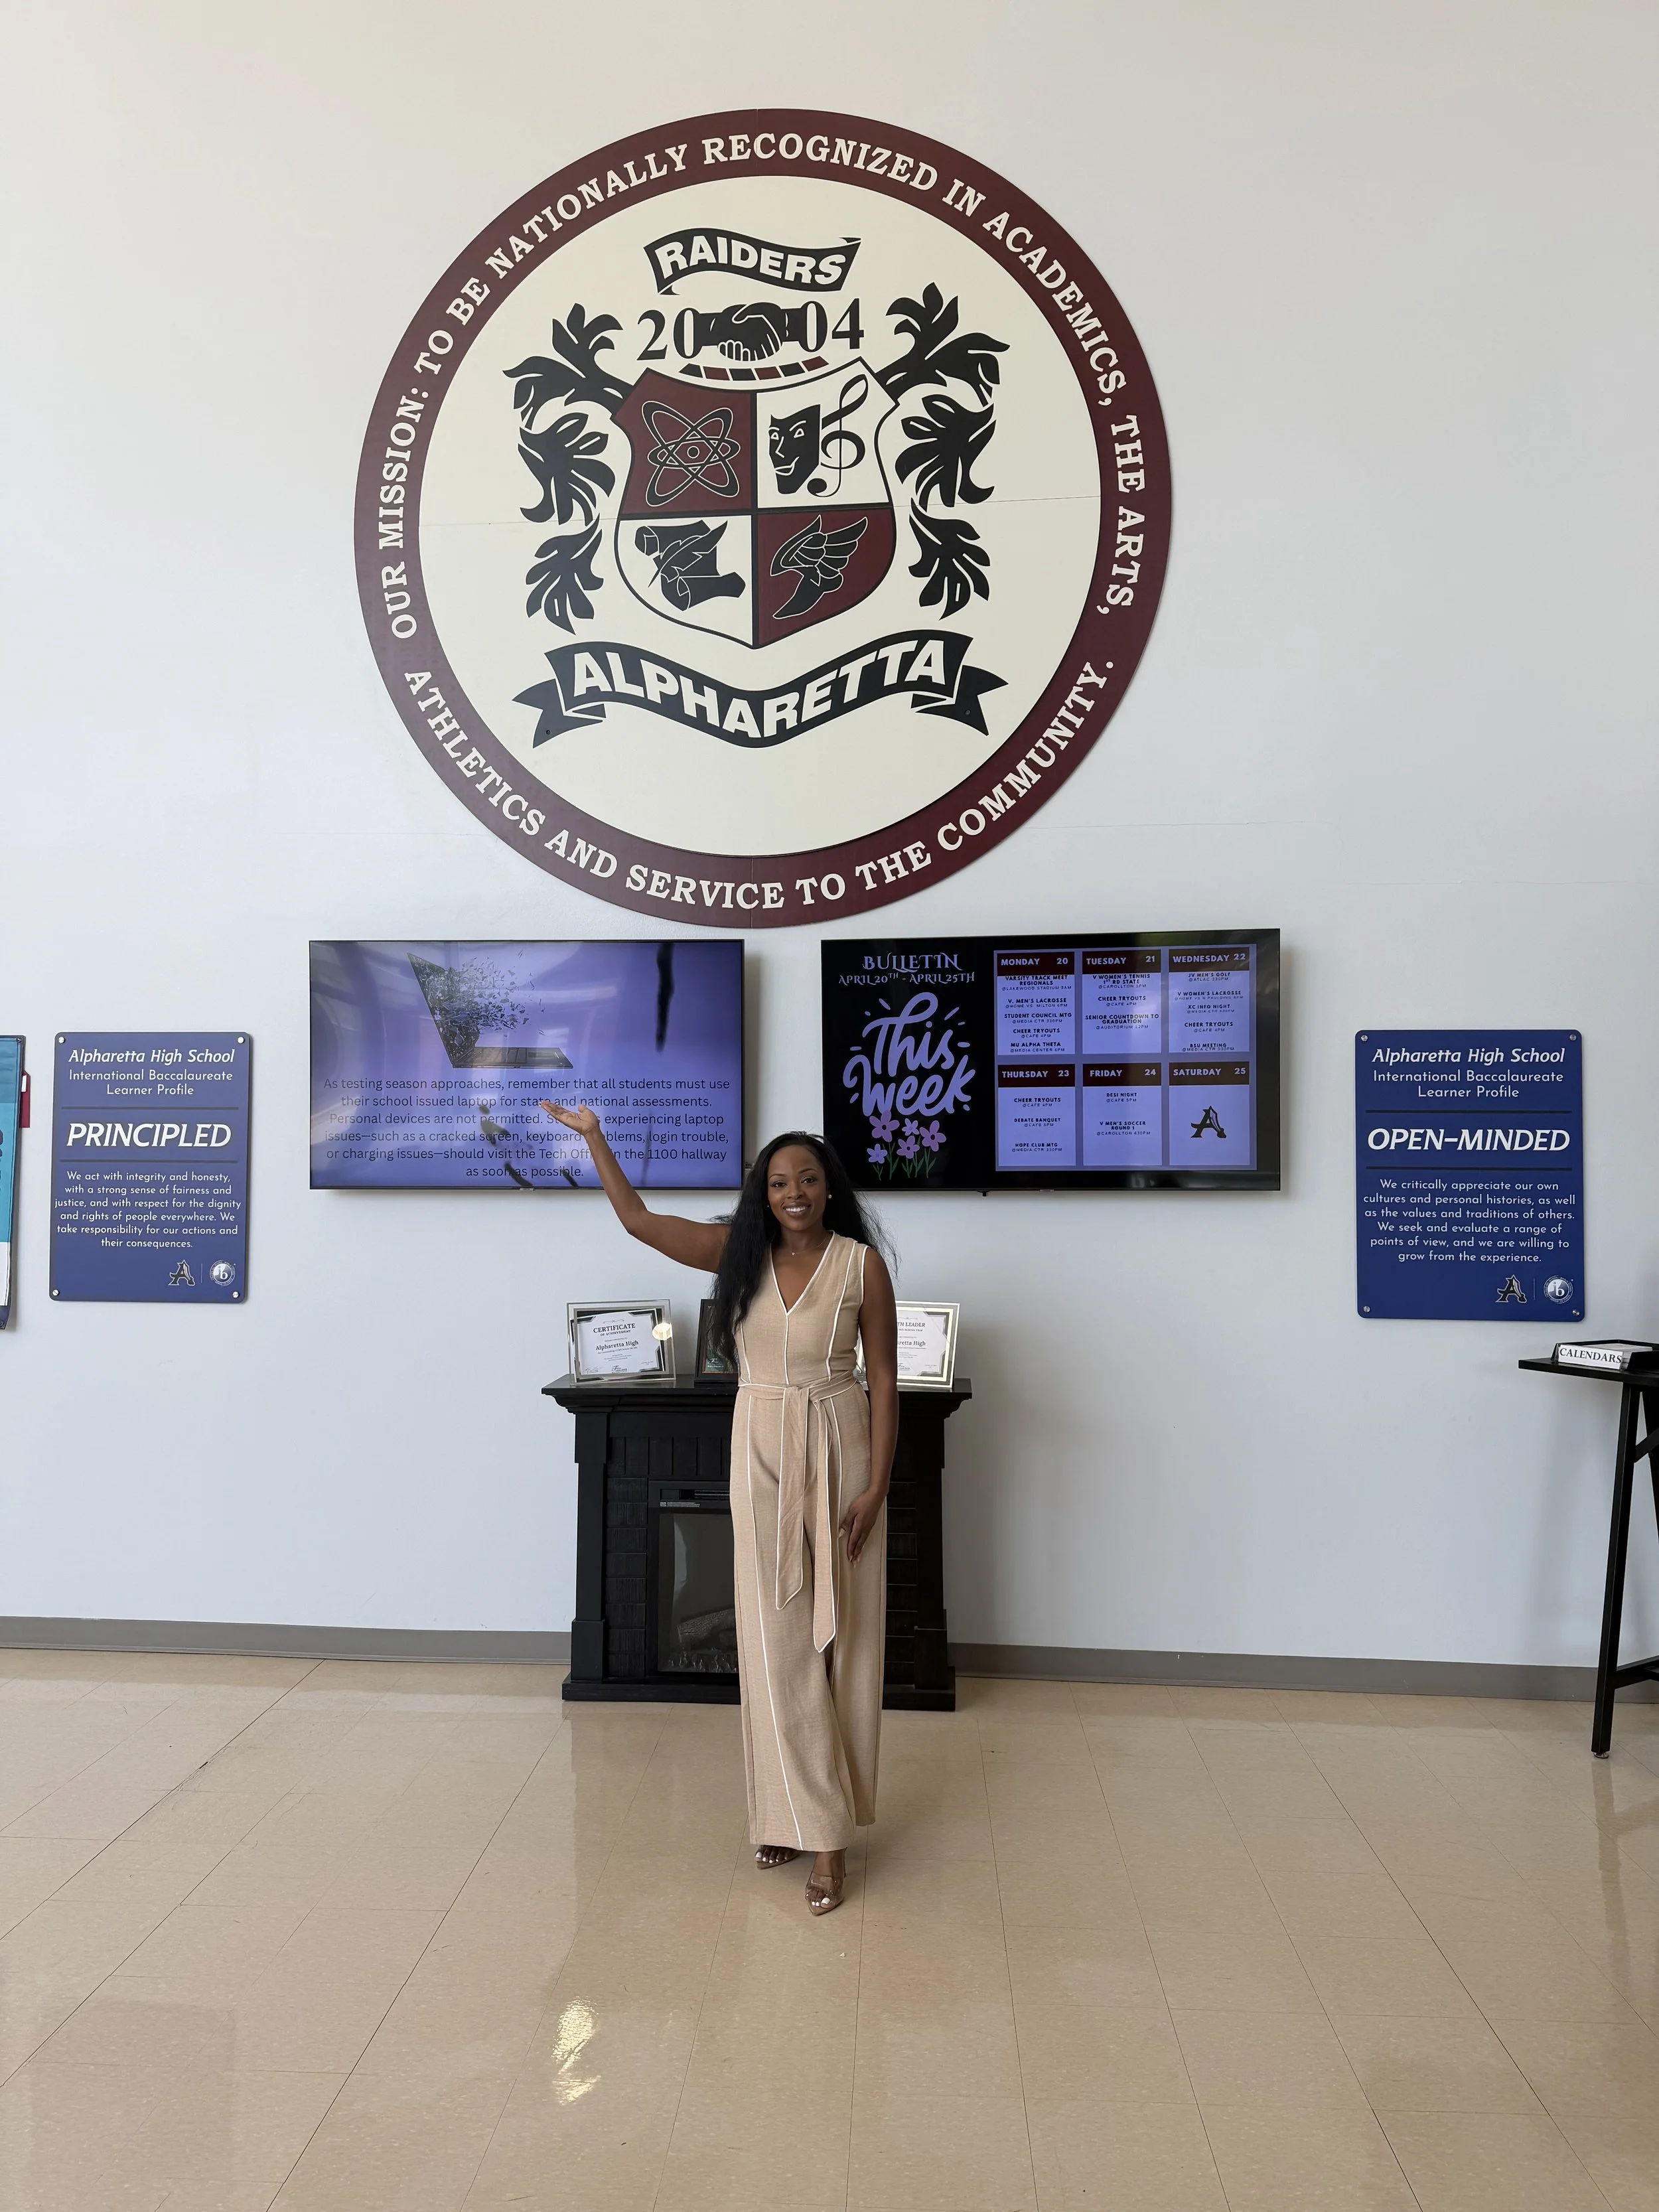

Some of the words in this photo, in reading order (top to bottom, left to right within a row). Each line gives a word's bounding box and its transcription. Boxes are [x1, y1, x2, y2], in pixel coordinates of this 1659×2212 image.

[701, 133, 938, 190] RECOGNIZED
[942, 179, 987, 217] IN
[484, 143, 687, 279] NATIONALLY
[655, 235, 846, 285] RAIDERS
[445, 277, 491, 326] BE
[982, 211, 1127, 406] ACADEMICS,
[413, 330, 454, 375] TO
[1110, 415, 1145, 493] THE
[378, 388, 429, 550] MISSION:
[1100, 506, 1145, 615] ARTS,
[381, 561, 417, 639] OUR
[573, 639, 946, 739] ALPHARETTA
[403, 671, 546, 836] ATHLETICS
[543, 829, 618, 878] AND
[625, 864, 785, 909] SERVICE
[795, 873, 845, 905] TO
[855, 840, 932, 891] THE
[937, 661, 1114, 851] COMMUNITY.
[862, 952, 963, 972] BULLETIN
[839, 974, 877, 986] APRIL
[910, 973, 948, 984] APRIL
[862, 992, 955, 1077] This
[68, 1049, 145, 1066] Alpharetta
[150, 1049, 182, 1066] High
[187, 1049, 235, 1063] School
[1372, 1047, 1461, 1066] Alpharetta
[1467, 1047, 1504, 1066] High
[1510, 1047, 1565, 1063] School
[70, 1069, 144, 1080] International
[149, 1069, 233, 1080] Baccalaureate
[1374, 1069, 1461, 1081] International
[1467, 1069, 1563, 1082] Baccalaureate
[107, 1084, 153, 1094] Learner
[157, 1083, 194, 1095] Profile
[324, 1078, 338, 1088] As
[341, 1078, 382, 1091] testing
[431, 1078, 504, 1091] approaches,
[508, 1078, 571, 1088] remember
[573, 1078, 599, 1089] that
[601, 1078, 616, 1089] all
[618, 1078, 672, 1089] students
[676, 1080, 705, 1089] must
[1418, 1085, 1471, 1097] Learner
[1477, 1085, 1519, 1097] Profile
[342, 1096, 369, 1106] their
[373, 1095, 413, 1106] school
[416, 1095, 453, 1106] issued
[458, 1095, 496, 1108] laptop
[500, 1095, 518, 1106] for
[555, 1096, 576, 1106] and
[580, 1096, 629, 1106] national
[632, 1096, 712, 1106] assessments.
[66, 1123, 231, 1147] PRINCIPLED
[66, 1171, 82, 1180] We
[103, 1171, 122, 1181] with
[126, 1173, 166, 1183] integrity
[169, 1171, 188, 1181] and
[192, 1171, 230, 1183] honesty,
[466, 1167, 478, 1176] as
[482, 1167, 511, 1176] soon
[531, 1165, 584, 1179] possible.
[64, 1184, 84, 1193] with
[97, 1186, 127, 1196] strong
[159, 1184, 169, 1194] of
[173, 1184, 210, 1194] fairness
[213, 1185, 232, 1195] and
[1380, 1179, 1398, 1189] We
[1401, 1179, 1447, 1191] critically
[1451, 1181, 1511, 1192] appreciate
[54, 1199, 86, 1209] justice,
[90, 1197, 108, 1207] and
[111, 1197, 131, 1207] with
[135, 1199, 169, 1209] respect
[172, 1197, 186, 1207] for
[189, 1198, 204, 1208] the
[208, 1198, 242, 1210] dignity
[1363, 1192, 1406, 1203] cultures
[1409, 1193, 1431, 1203] and
[1435, 1193, 1482, 1206] personal
[1486, 1193, 1534, 1206] histories,
[1554, 1194, 1575, 1205] well
[1381, 1207, 1398, 1217] the
[1402, 1207, 1437, 1218] values
[1441, 1207, 1462, 1218] and
[1466, 1208, 1519, 1218] traditions
[1523, 1208, 1534, 1218] of
[1538, 1209, 1575, 1219] others.
[593, 1323, 636, 1333] CERTIFICATE
[596, 1342, 624, 1351] Alpharetta
[1560, 1348, 1622, 1363] CALENDARS
